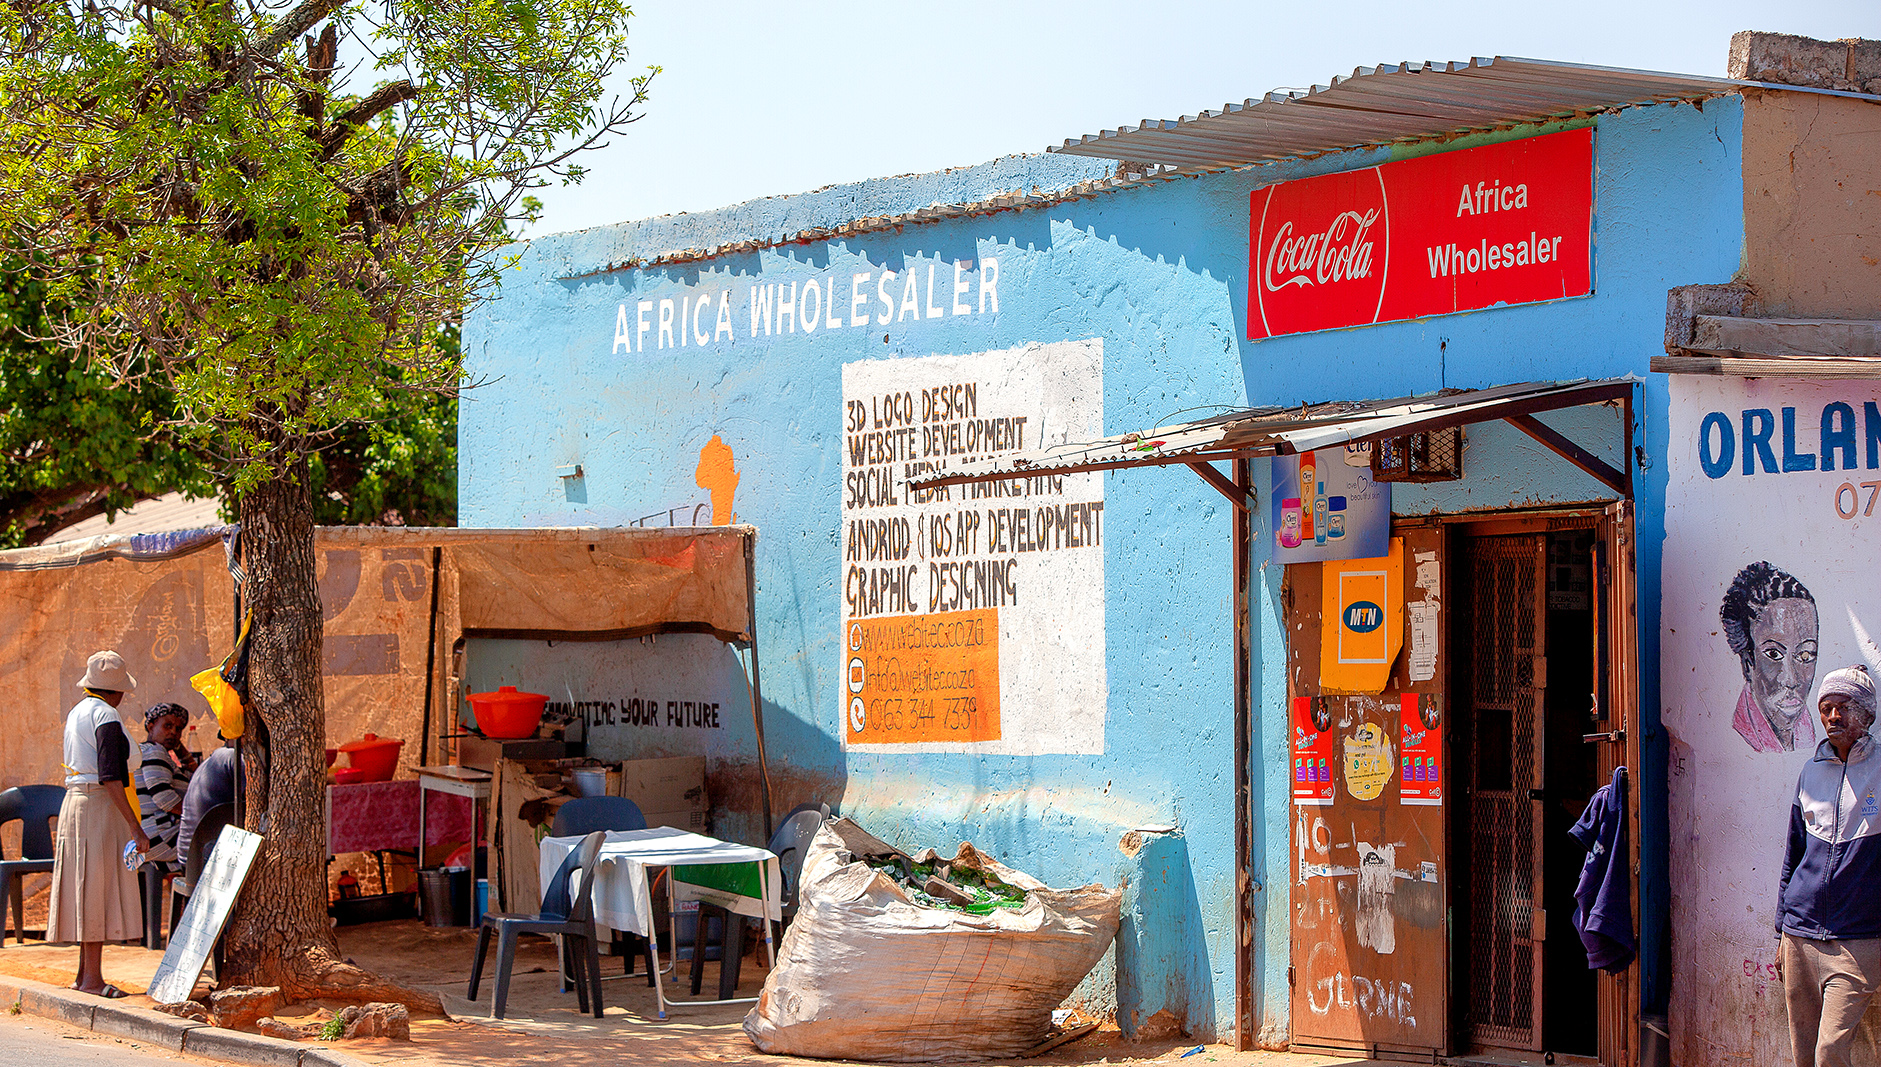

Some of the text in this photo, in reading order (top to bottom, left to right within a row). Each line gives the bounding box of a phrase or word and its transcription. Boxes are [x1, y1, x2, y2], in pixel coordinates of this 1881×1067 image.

[1456, 179, 1528, 218] Africa
[1265, 205, 1382, 292] Coca-Cola
[1427, 231, 1562, 279] Wholesaler
[611, 257, 999, 355] AFRICA WHOLESALER
[847, 382, 977, 433] 3D LOGO DESIGN
[847, 416, 1028, 467] WEBSITE DEVELOPMENT
[847, 467, 898, 510] SOCIAL
[847, 516, 911, 561] ANDRIOD
[956, 510, 981, 555] APP
[988, 501, 1104, 554] DEVELOPMENT
[846, 558, 1018, 617] GRAPHIC DESIGNING
[1349, 608, 1377, 626] MTN
[620, 698, 659, 727] YOUR
[667, 702, 720, 729] FUTURE
[870, 697, 978, 731] 063 344 7339
